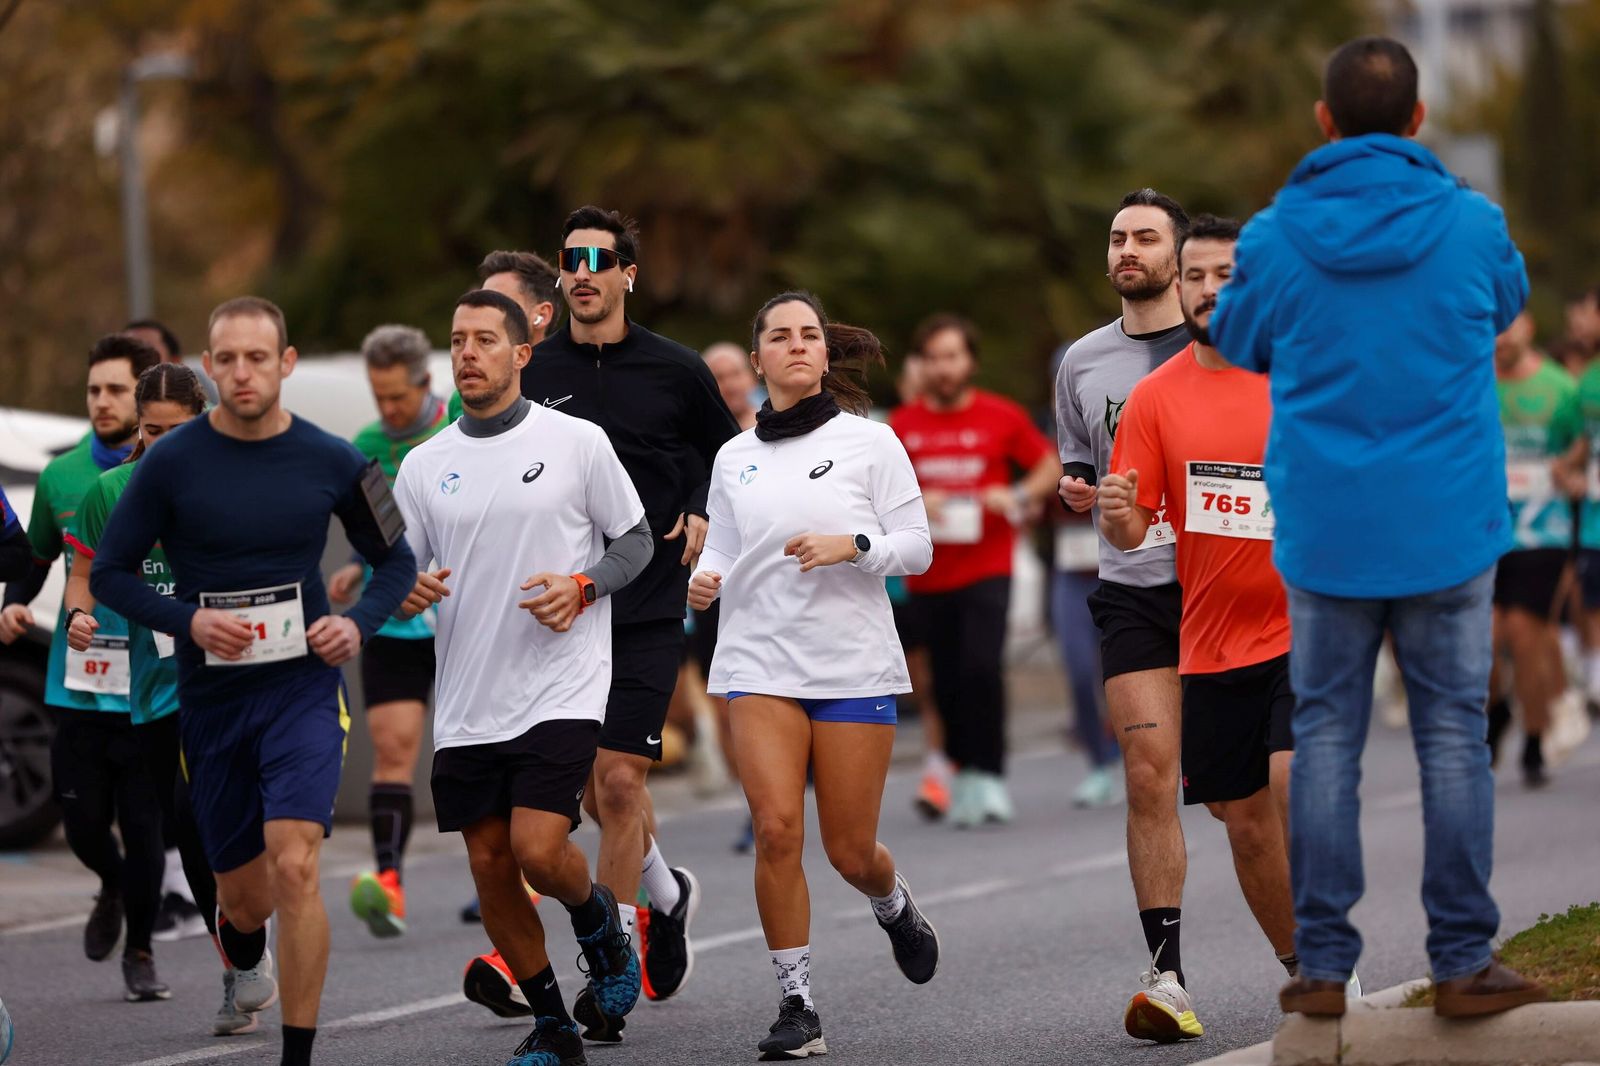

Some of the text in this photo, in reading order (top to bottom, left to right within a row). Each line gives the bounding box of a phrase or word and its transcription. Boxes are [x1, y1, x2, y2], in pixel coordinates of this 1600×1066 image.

[1240, 470, 1261, 478] 2026
[1201, 491, 1251, 515] 765
[142, 559, 164, 574] En
[84, 660, 111, 675] 87
